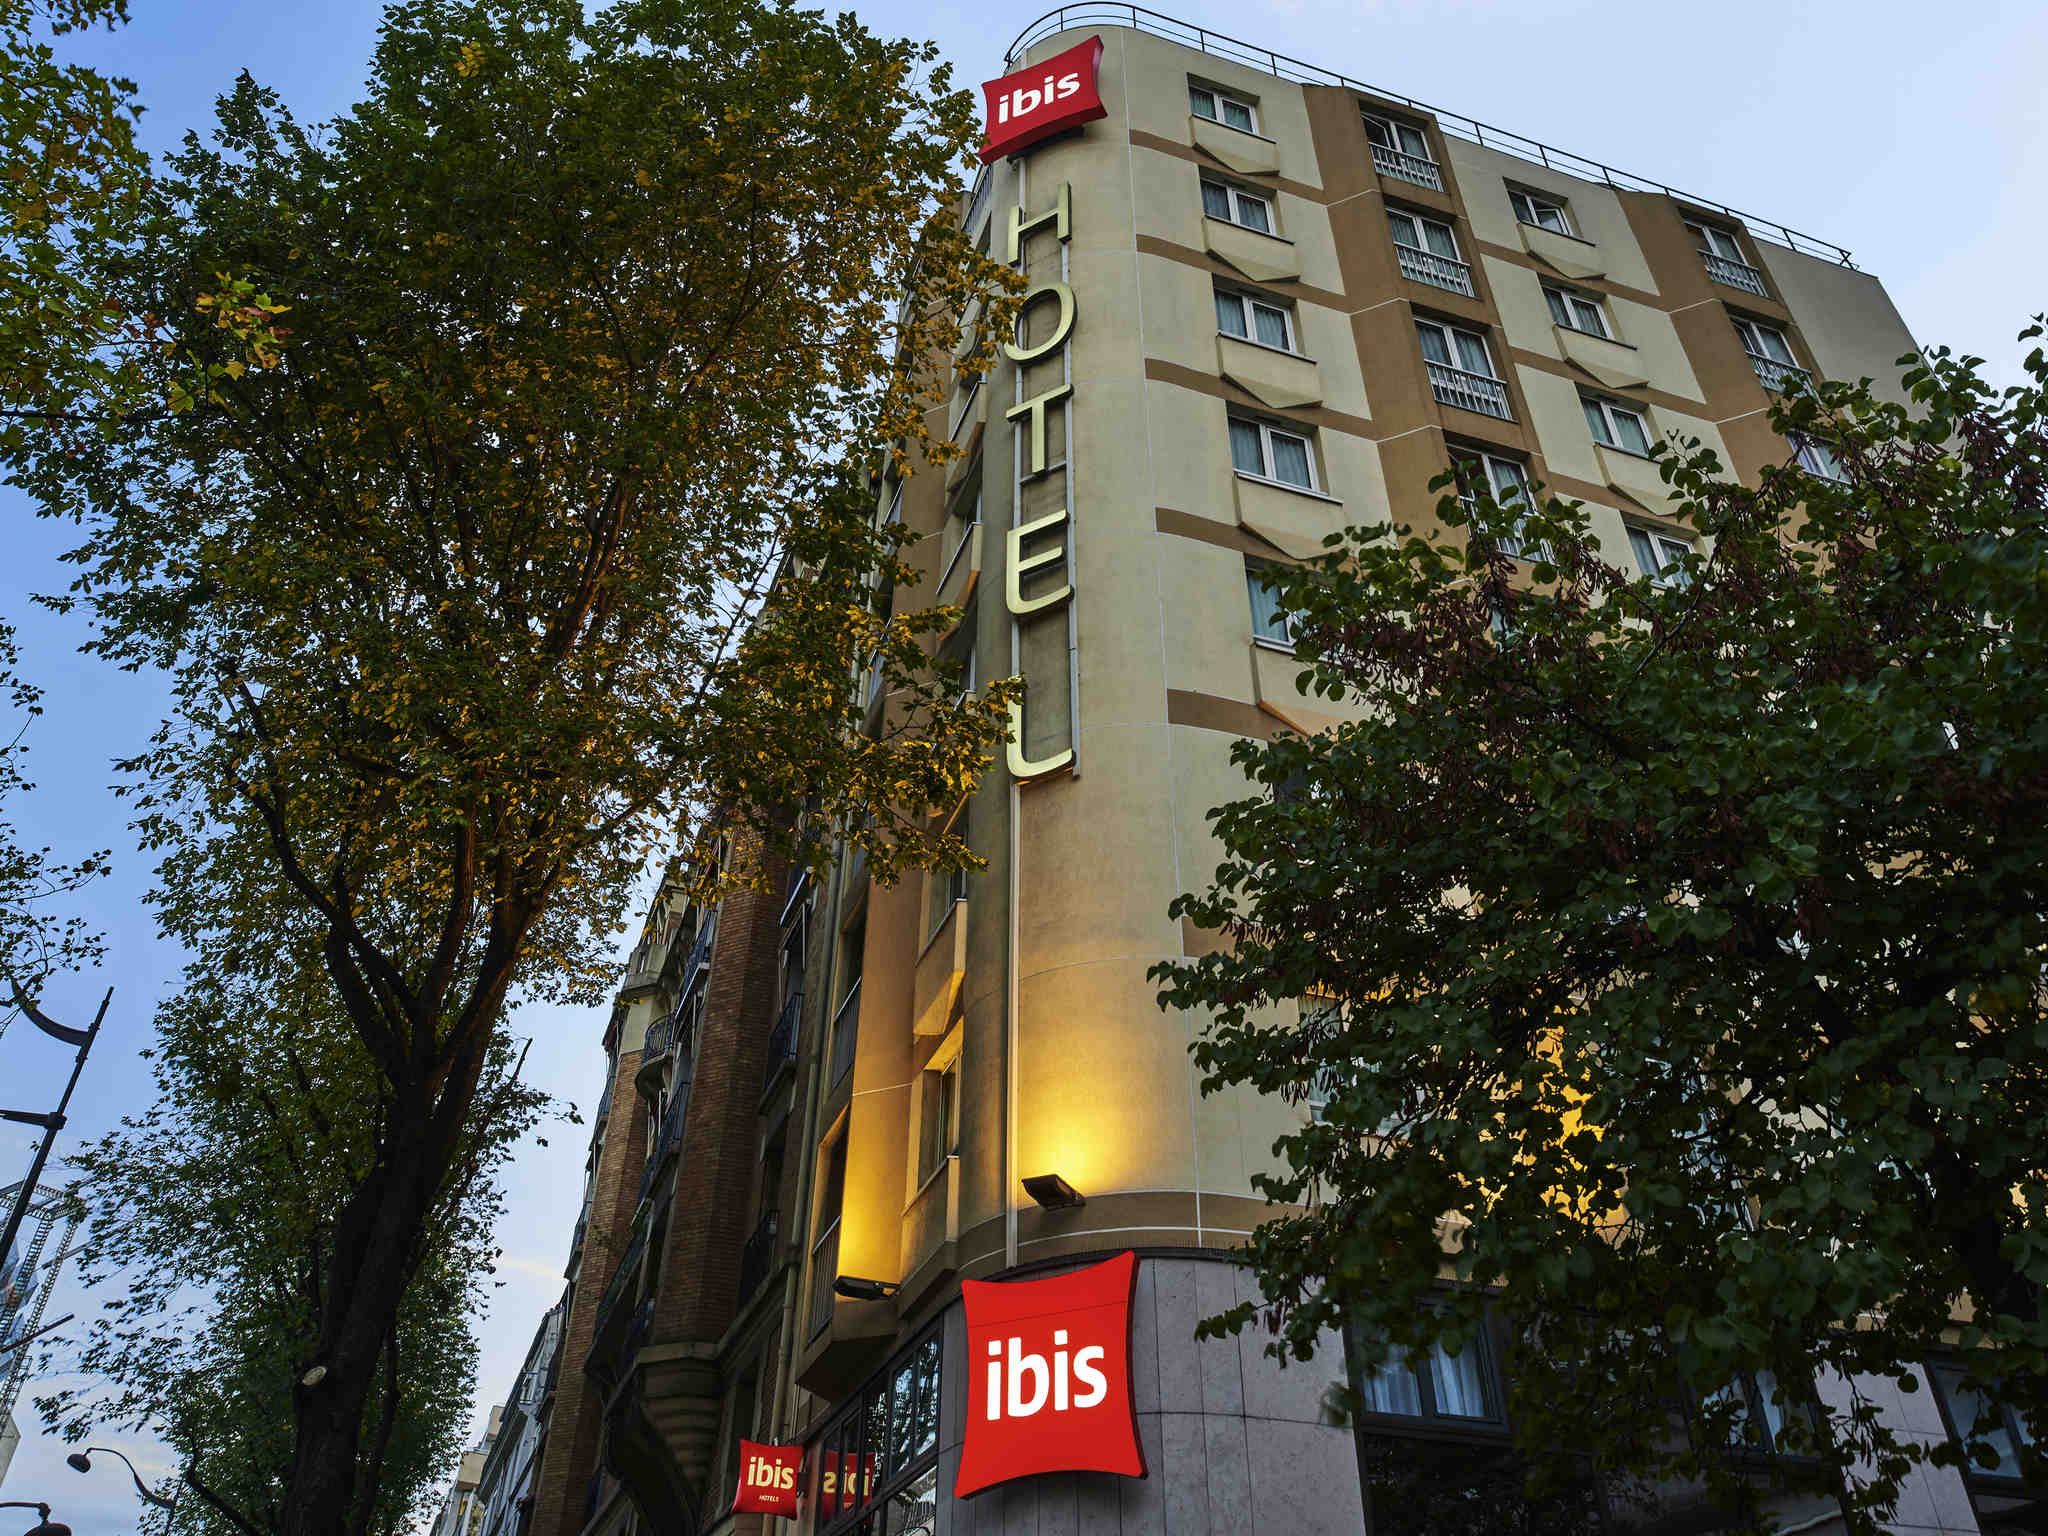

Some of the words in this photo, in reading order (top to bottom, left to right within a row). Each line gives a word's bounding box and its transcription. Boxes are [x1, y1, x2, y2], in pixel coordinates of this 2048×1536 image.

[998, 72, 1081, 124] ibis
[1003, 180, 1077, 784] HOTEL
[986, 1329, 1108, 1421] ibis
[746, 1456, 794, 1490] ibis
